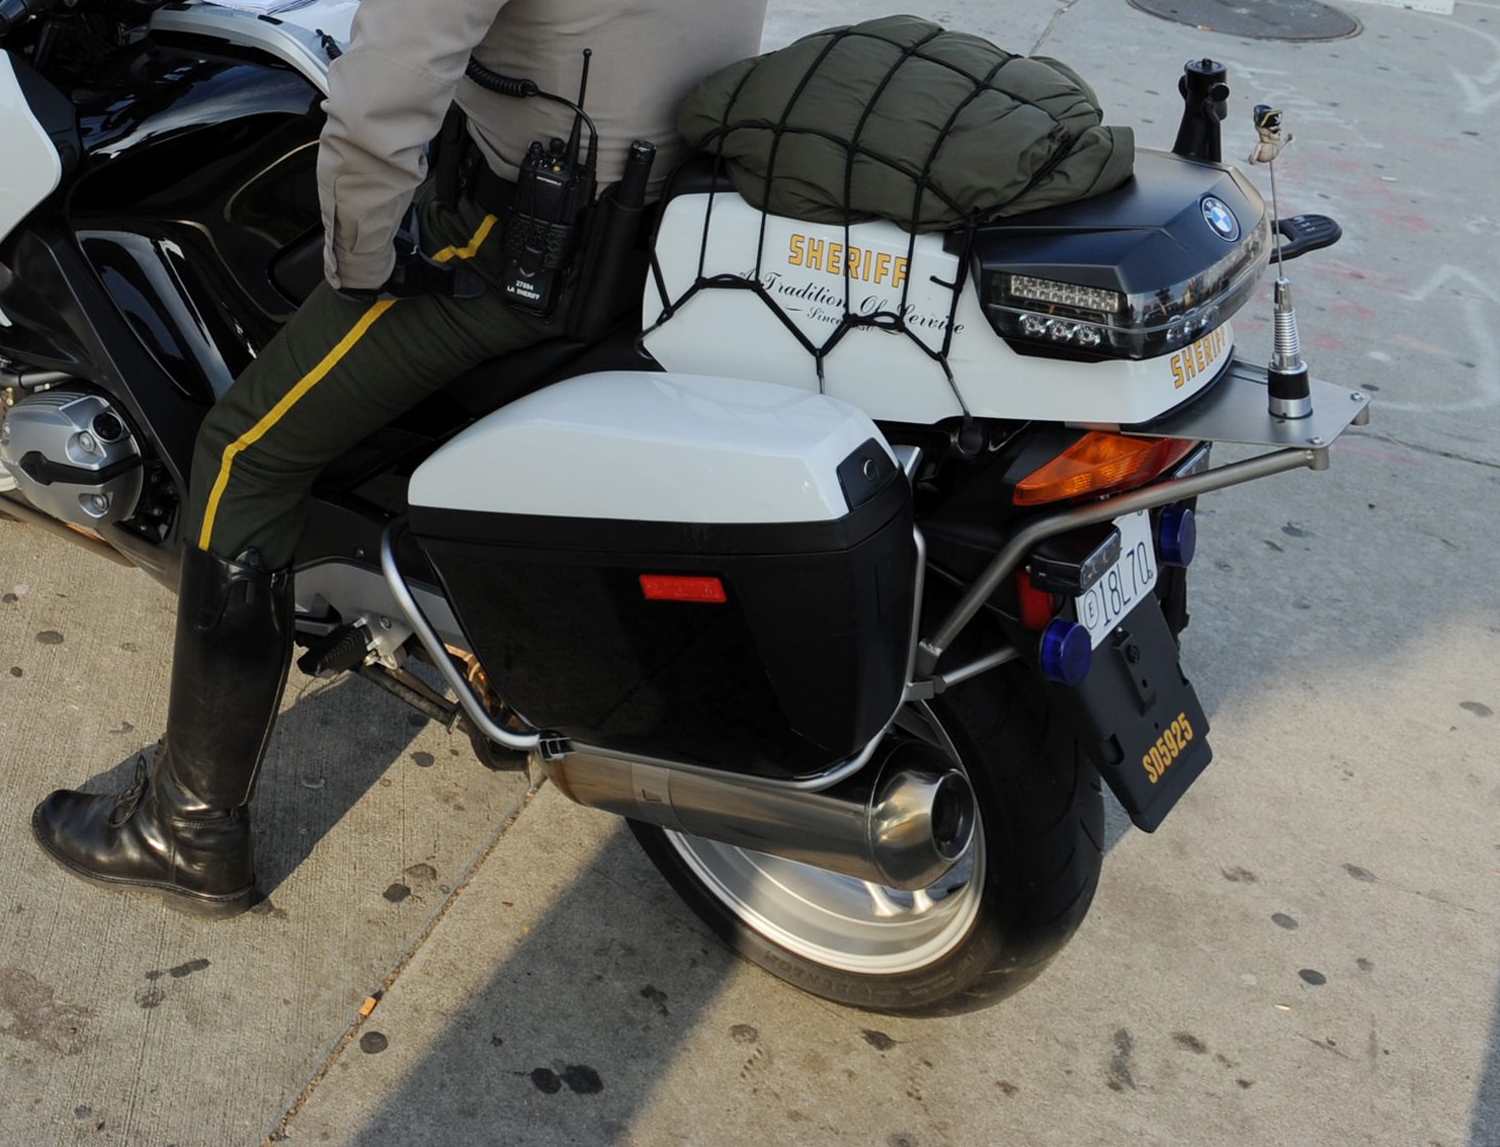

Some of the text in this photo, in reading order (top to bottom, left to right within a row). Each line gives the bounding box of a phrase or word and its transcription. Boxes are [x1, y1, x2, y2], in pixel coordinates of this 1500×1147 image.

[764, 271, 848, 309] Tradition
[788, 233, 908, 289] SHERIFF
[1170, 324, 1226, 389] SHERIFF
[1100, 541, 1150, 628] 18L70
[1142, 712, 1194, 784] SD5925
